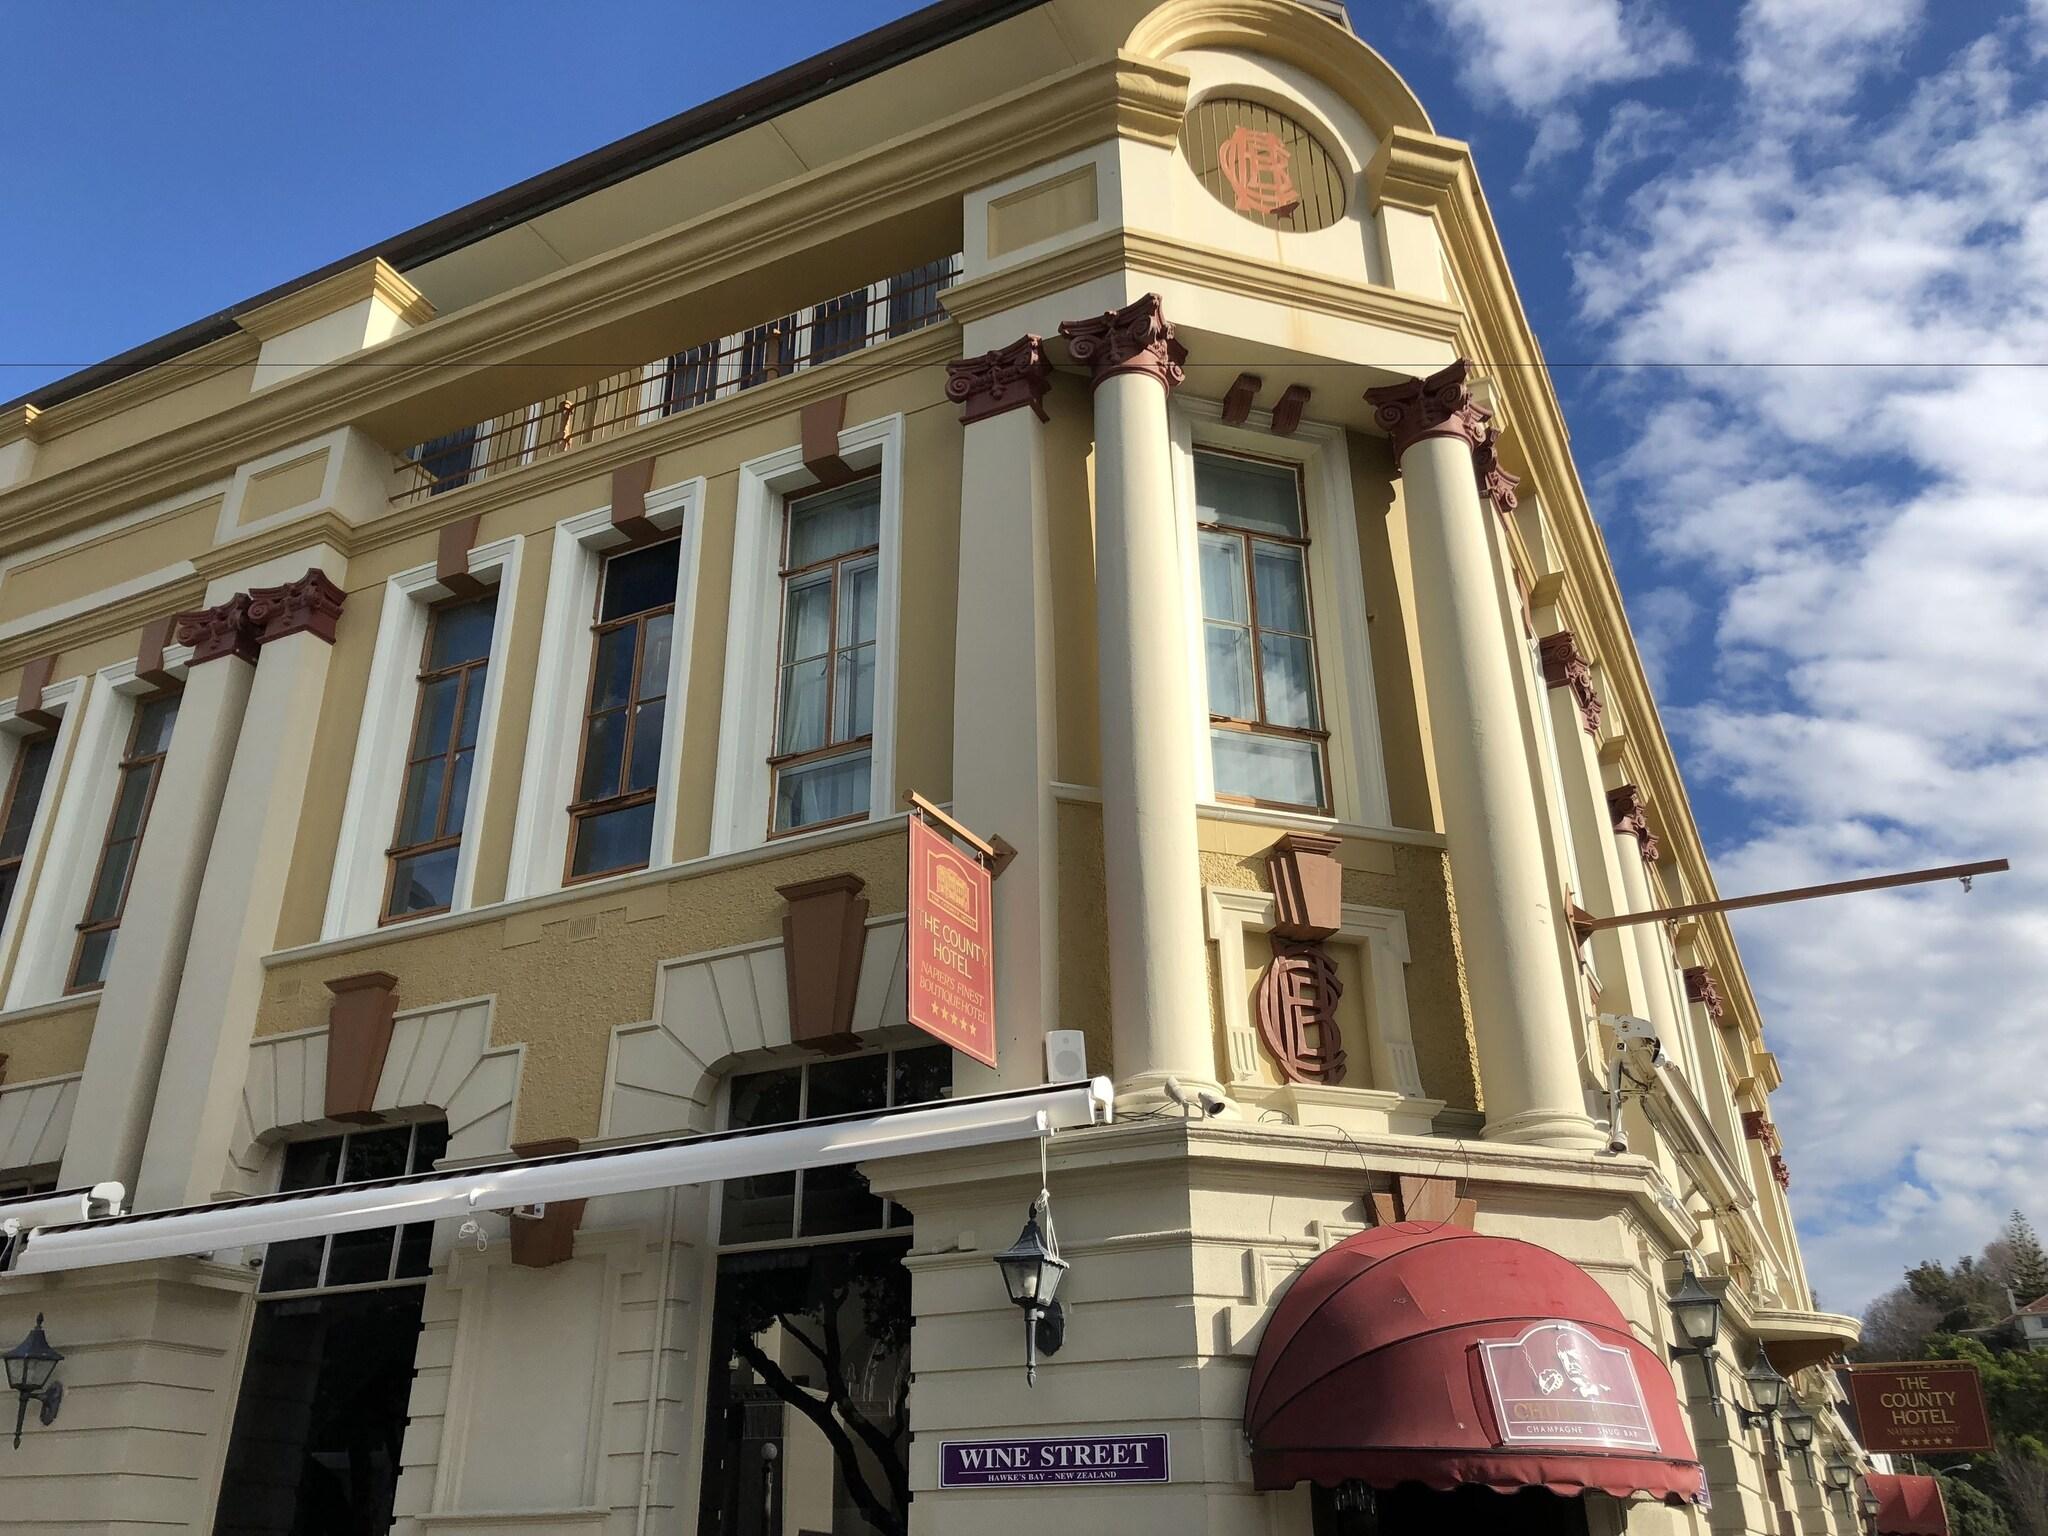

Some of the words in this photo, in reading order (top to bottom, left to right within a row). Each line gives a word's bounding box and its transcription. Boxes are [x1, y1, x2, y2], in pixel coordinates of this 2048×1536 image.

[917, 908, 941, 938] THE
[942, 925, 988, 968] COUNTY
[933, 938, 973, 979] HOTEL
[920, 960, 955, 990] NAPIER'S
[957, 982, 985, 1007] FINEST
[919, 975, 962, 1009] BOUTIQUE
[962, 1000, 988, 1024] HOTEL
[1895, 1376, 1931, 1390] THE
[1880, 1391, 1956, 1408] COUNTY
[1891, 1409, 1955, 1425] HOTEL
[1526, 1425, 1584, 1434] CHAMPAGNE
[959, 1447, 1031, 1470] WINE
[1040, 1442, 1148, 1467] STREET
[988, 1473, 1026, 1482] HAWKE'S
[1028, 1472, 1045, 1481] BAY
[1055, 1472, 1074, 1480] NEW
[1076, 1471, 1117, 1480] ZEALAND
